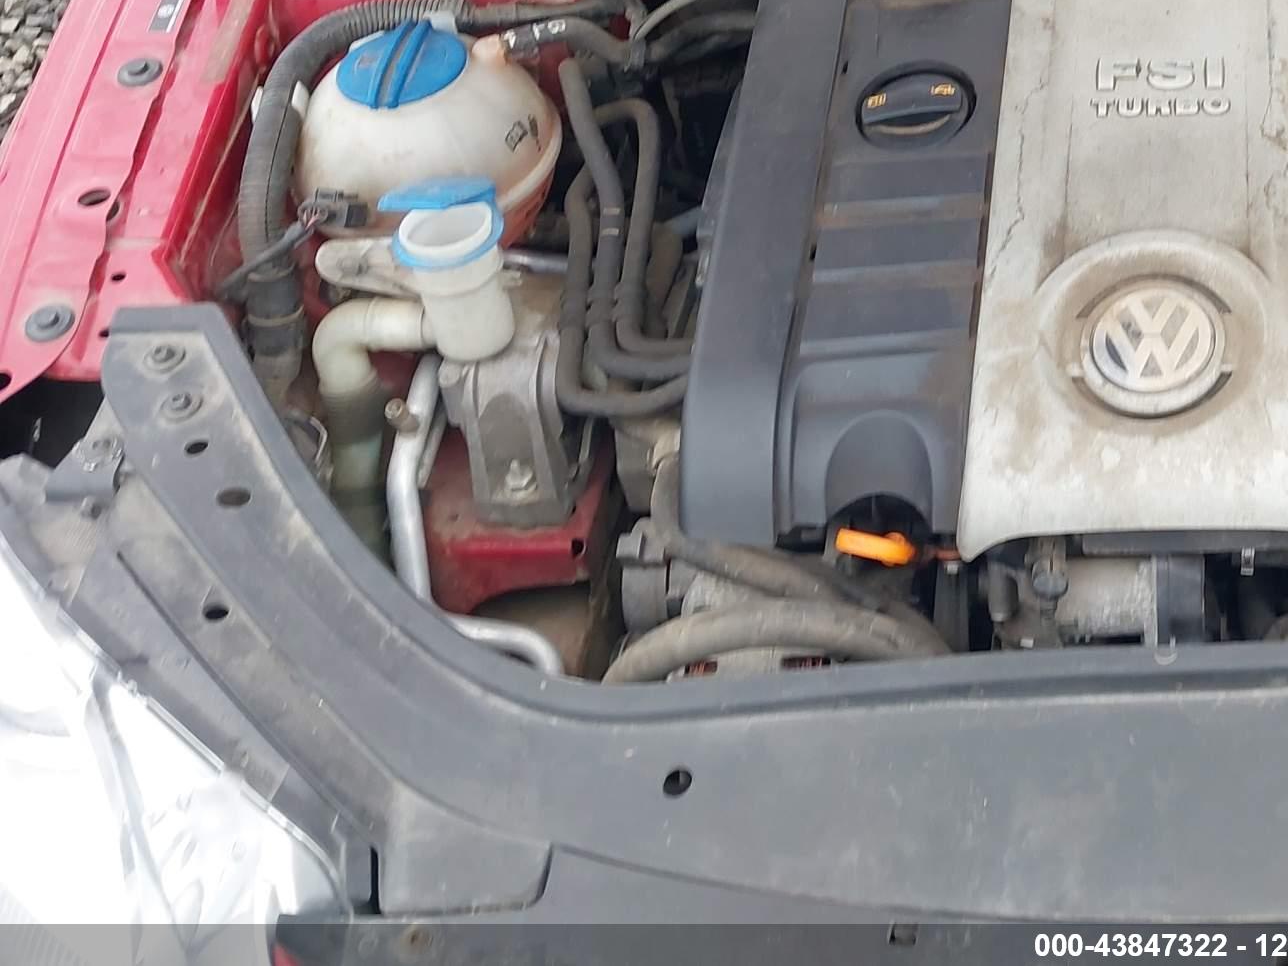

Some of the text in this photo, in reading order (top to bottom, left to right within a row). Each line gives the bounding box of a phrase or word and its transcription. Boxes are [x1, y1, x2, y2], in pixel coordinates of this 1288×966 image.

[1095, 56, 1225, 91] FSI
[1089, 97, 1231, 118] TURBO
[1092, 288, 1214, 393] VW
